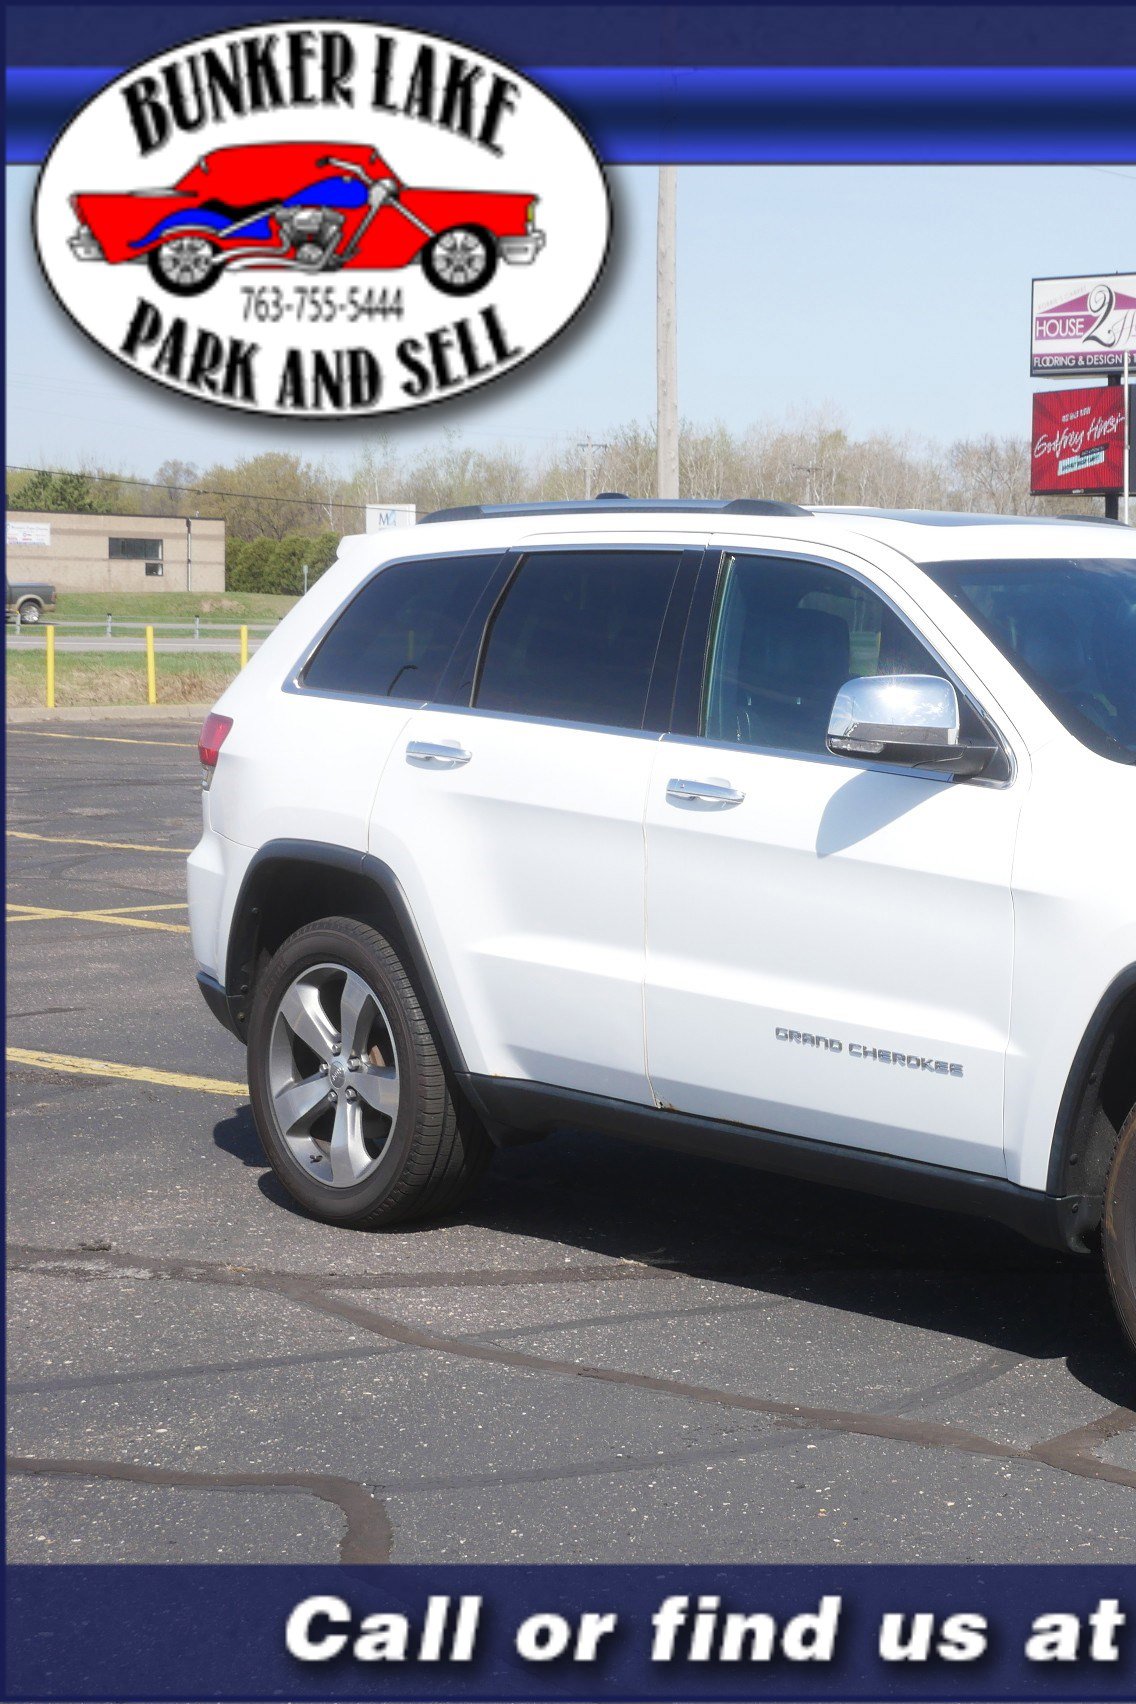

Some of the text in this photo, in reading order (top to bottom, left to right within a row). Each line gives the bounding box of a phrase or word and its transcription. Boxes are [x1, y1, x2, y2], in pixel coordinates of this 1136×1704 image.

[1036, 318, 1085, 337] HOUSE
[1082, 284, 1116, 348] 2
[1033, 355, 1076, 367] FLOORING
[1077, 355, 1085, 366] &
[1086, 353, 1123, 365] DESIGN
[775, 1026, 964, 1078] GRAND CHEROKEE
